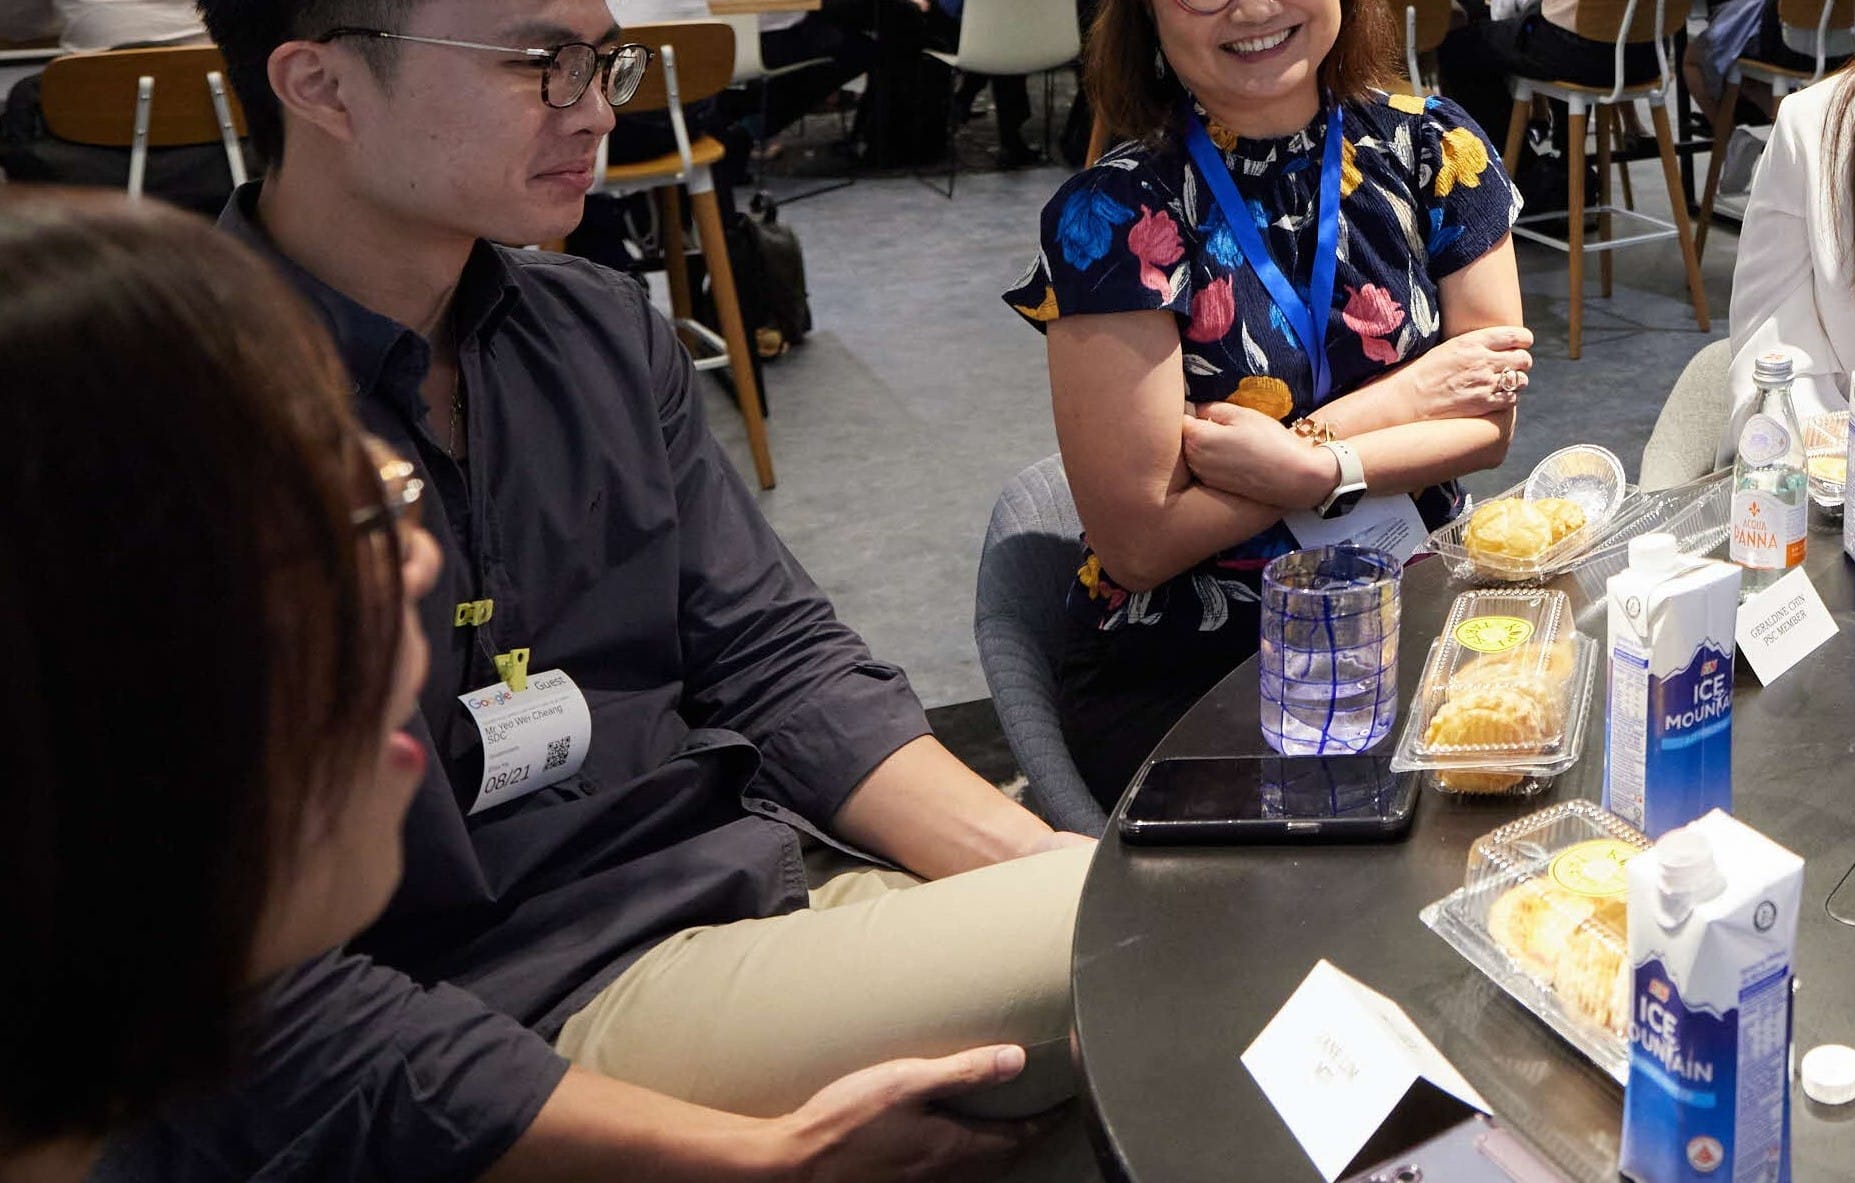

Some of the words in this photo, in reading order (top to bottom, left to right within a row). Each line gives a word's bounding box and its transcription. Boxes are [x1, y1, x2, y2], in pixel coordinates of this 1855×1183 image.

[1735, 525, 1777, 549] PANNA
[1743, 518, 1767, 530] ACQUA
[1750, 606, 1789, 638] GERALDINE
[1763, 631, 1778, 647] PSC
[1777, 609, 1806, 635] MEMBER
[535, 677, 567, 691] Guest
[1693, 674, 1725, 704] ICE
[485, 726, 497, 736] Mr
[499, 721, 514, 731] Yeo
[532, 704, 563, 721] Cheang
[1664, 695, 1730, 730] MOUNTA
[484, 764, 530, 794] 08/21
[1640, 994, 1679, 1042] ICE
[1627, 1022, 1714, 1083] OUNTAIN
